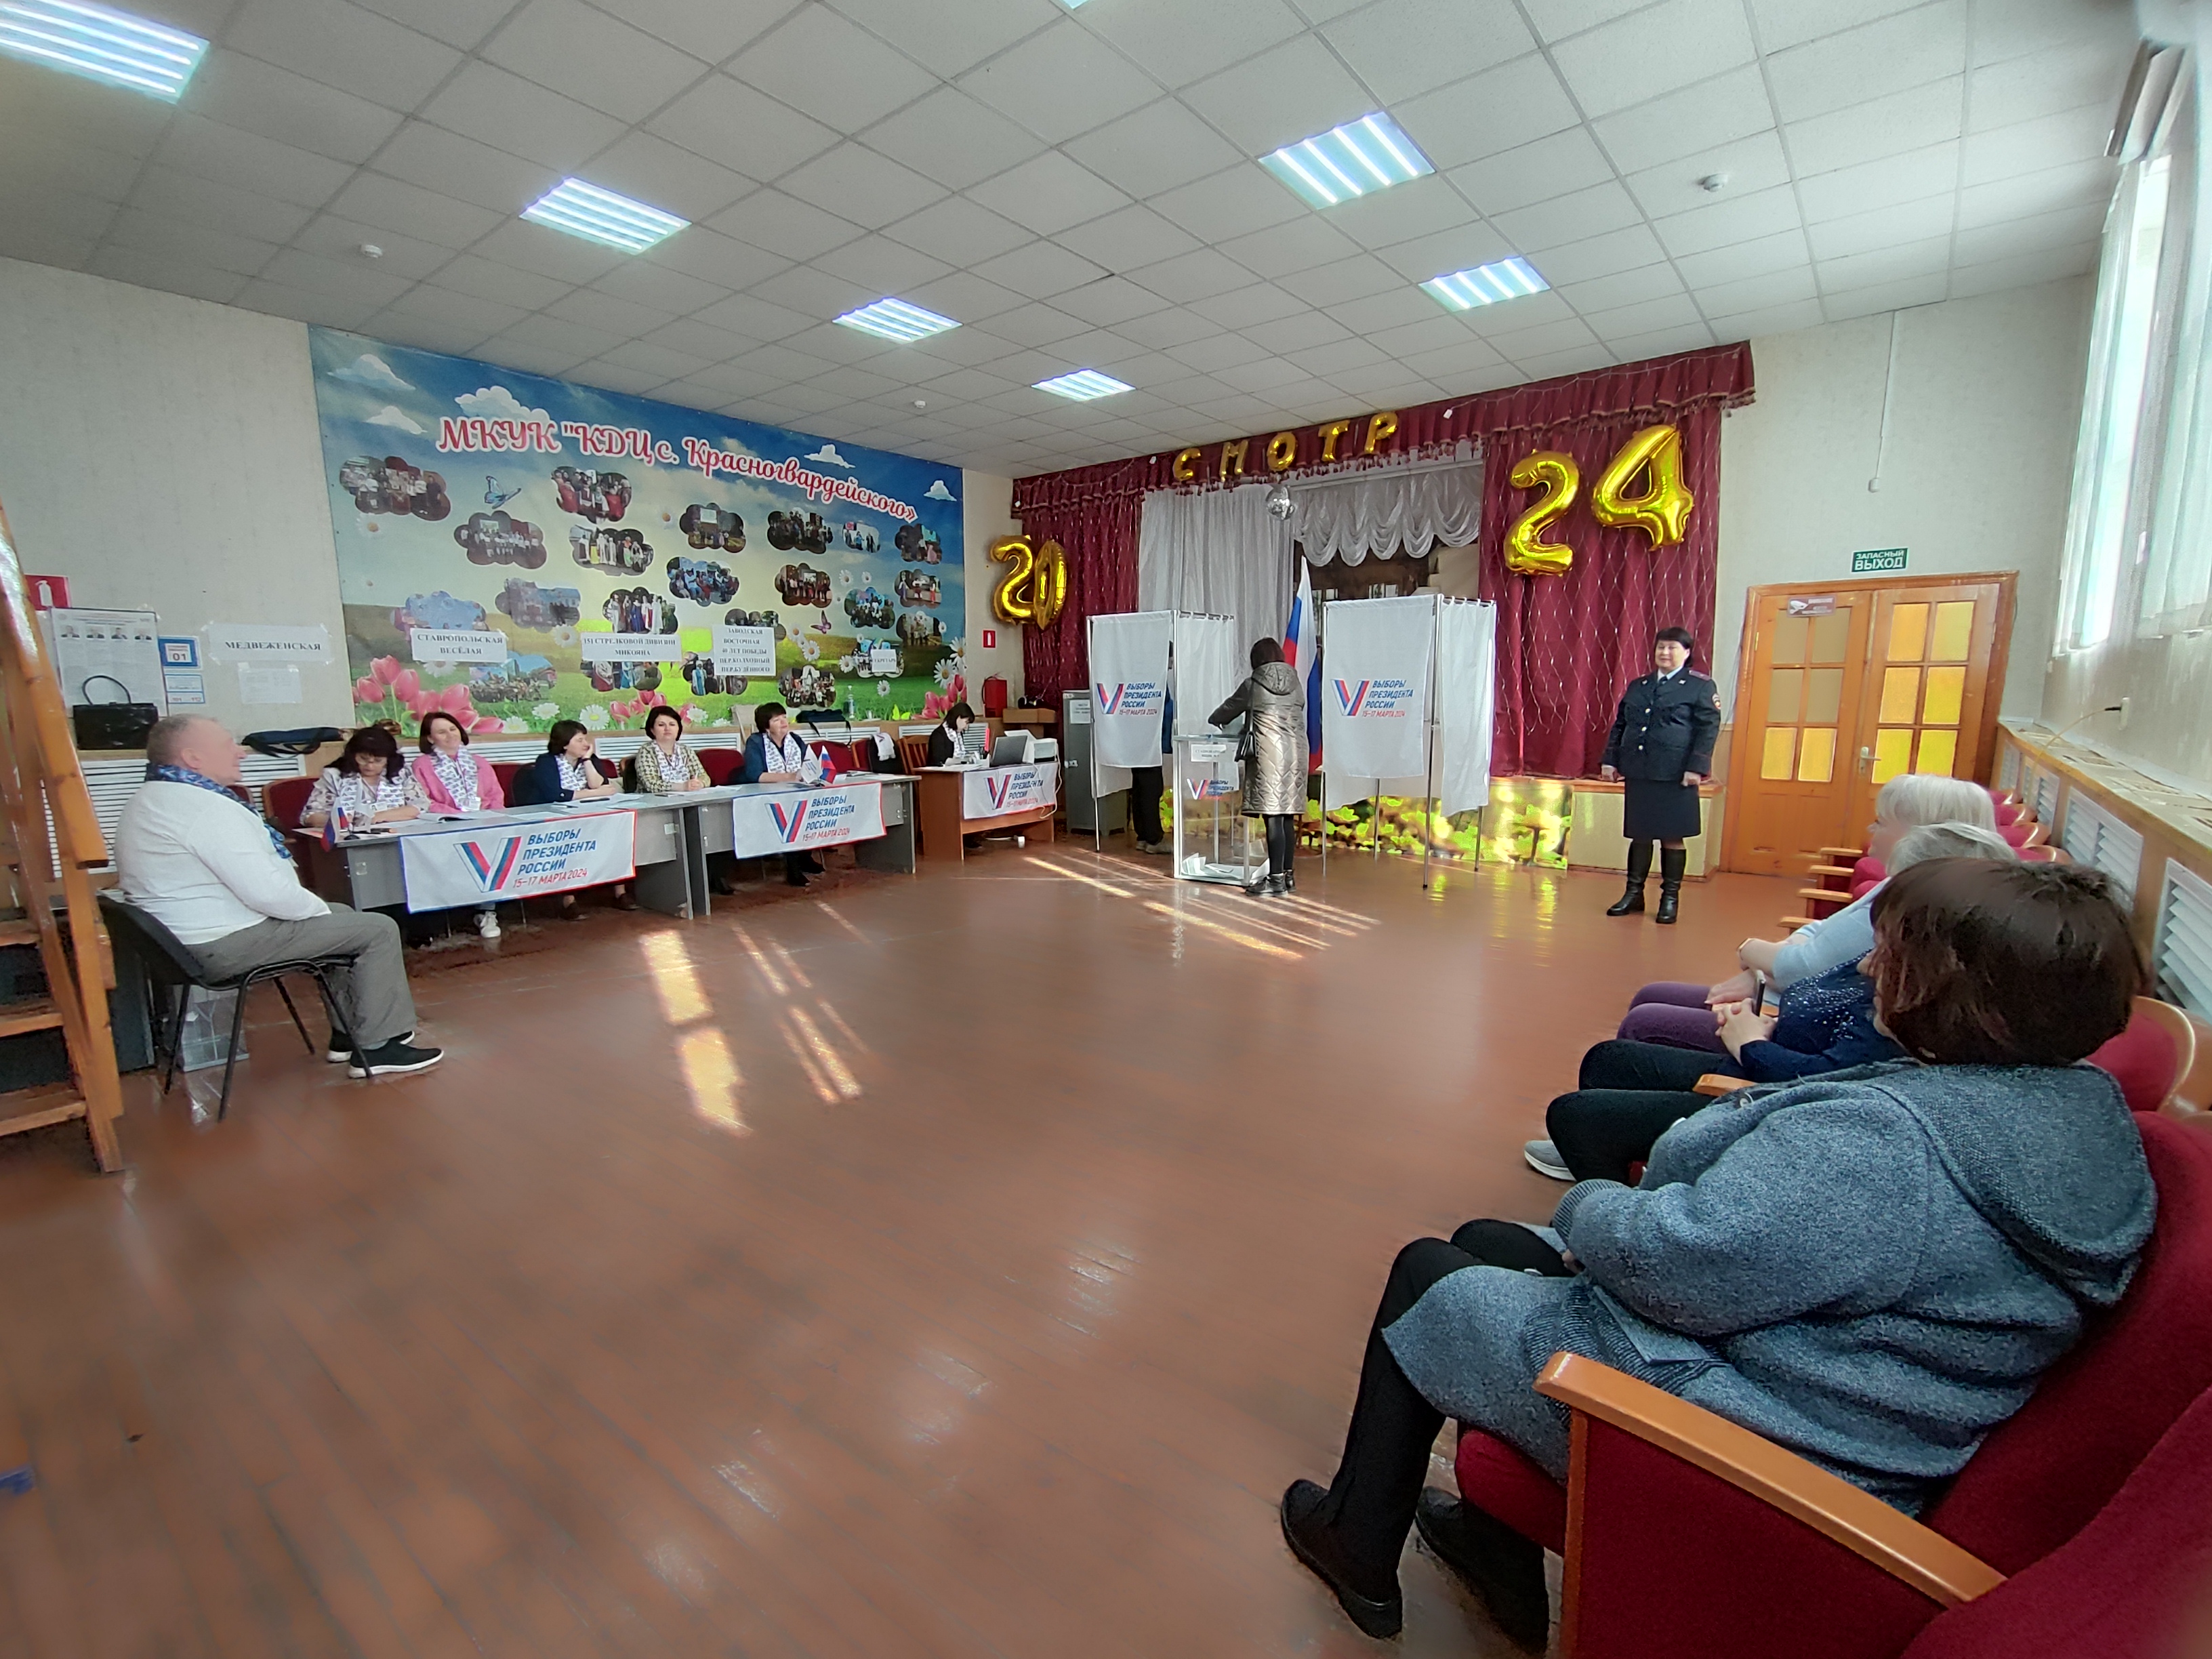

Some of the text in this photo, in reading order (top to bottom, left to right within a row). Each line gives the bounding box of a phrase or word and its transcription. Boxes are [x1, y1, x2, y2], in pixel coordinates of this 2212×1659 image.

[439, 419, 559, 451] МКУК
[657, 441, 677, 462] с.
[1173, 411, 1397, 482] СМОТР
[1504, 424, 1694, 577] 24
[1856, 550, 1904, 560] ЗАПАСНЫЙ
[1854, 557, 1904, 571] ВЫХОД
[990, 534, 1067, 630] 20
[417, 634, 503, 643] СТАВРОПОЛЬСКАЯ
[225, 641, 321, 651] МЕДВЕЖЕНСКАЯ
[440, 646, 483, 655] ВЕСЁЛАЯ
[172, 653, 186, 661] 01
[1372, 680, 1406, 688] ВЫБОРЫ
[1124, 691, 1162, 699] ПРЕЗИДЕНТА
[1369, 689, 1414, 699] ПРЕЗИДЕНТА
[1014, 771, 1037, 781] ВЫБОРЫ
[811, 795, 847, 807] ВЫБОРЫ
[808, 805, 855, 819] ПРЕЗИДЕНТА
[805, 819, 837, 832] РОССИИ
[527, 828, 581, 845] ВЫБОРЫ
[817, 830, 837, 839] МАРТА
[523, 840, 596, 860] ПРЕЗИДЕНТА
[517, 858, 567, 876] РОССИИ
[538, 872, 567, 884] МАРТА
[567, 868, 588, 879] 2024
